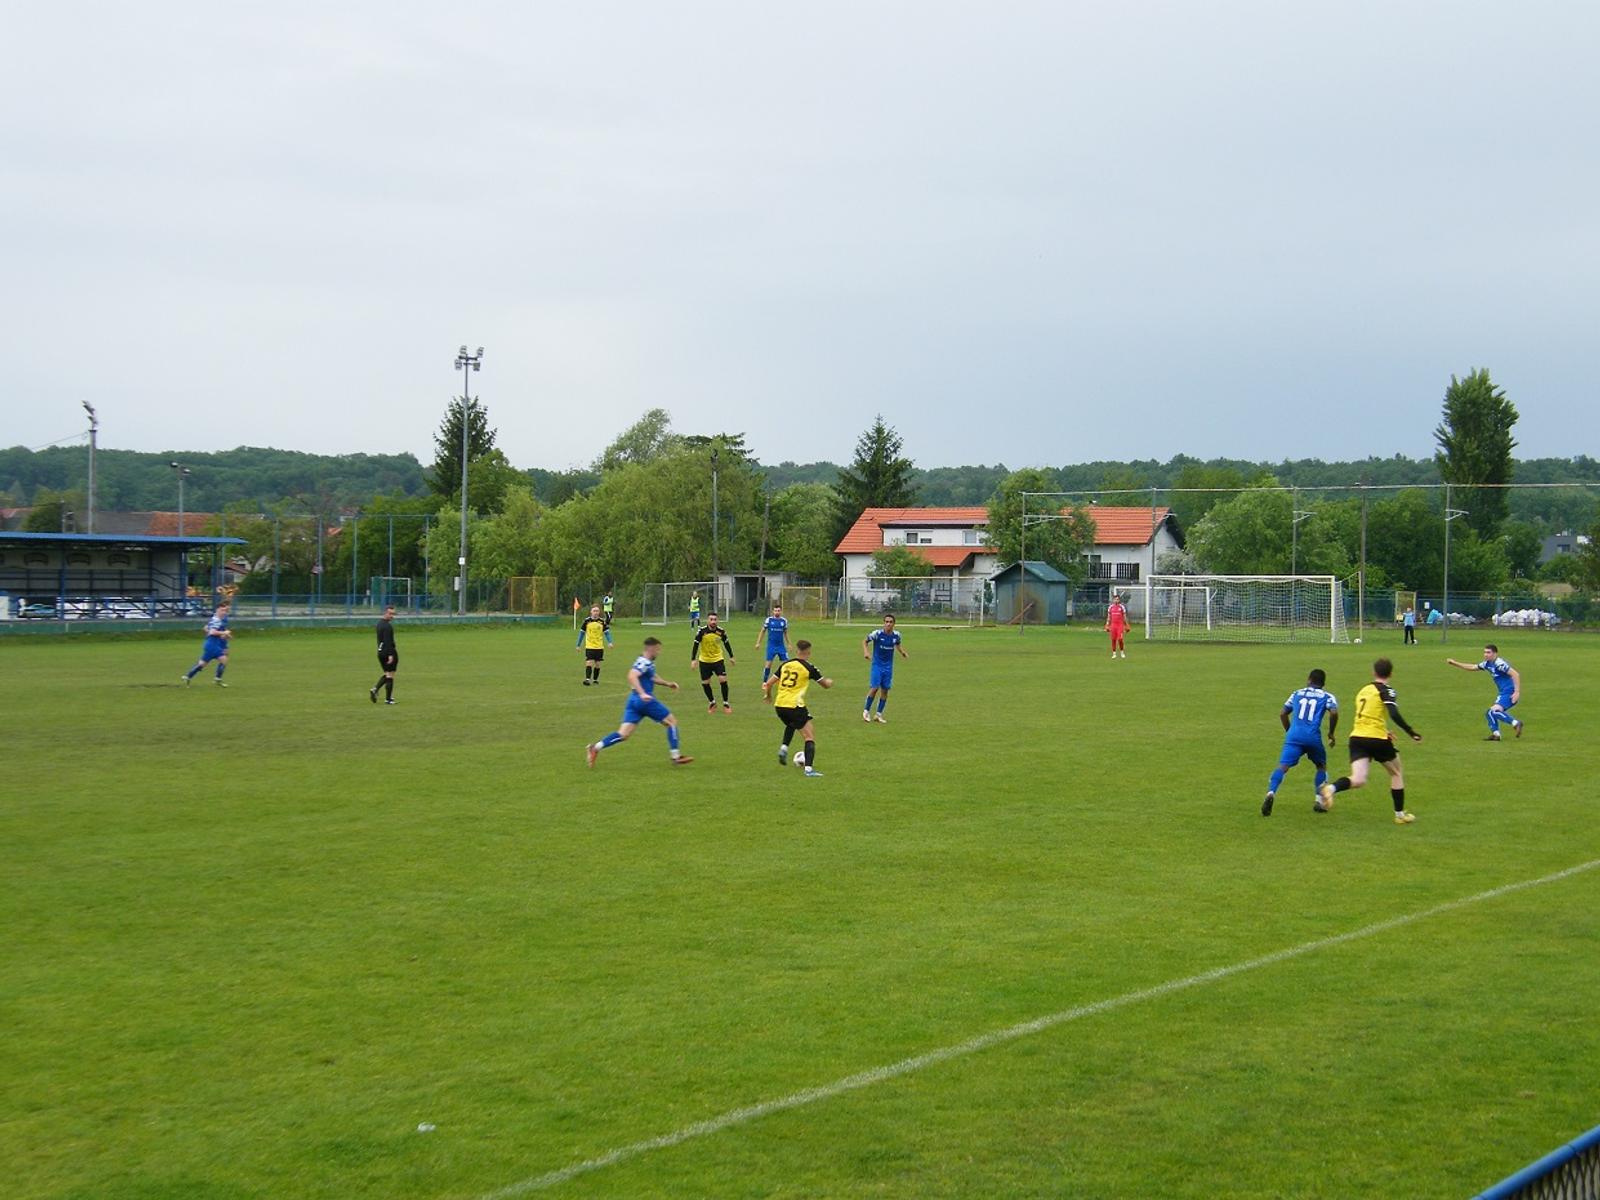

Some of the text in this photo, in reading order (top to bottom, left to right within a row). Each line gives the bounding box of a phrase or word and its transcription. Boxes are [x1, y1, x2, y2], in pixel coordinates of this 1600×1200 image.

[781, 670, 798, 688] 23
[1298, 698, 1317, 721] 11
[1358, 698, 1366, 718] 7
